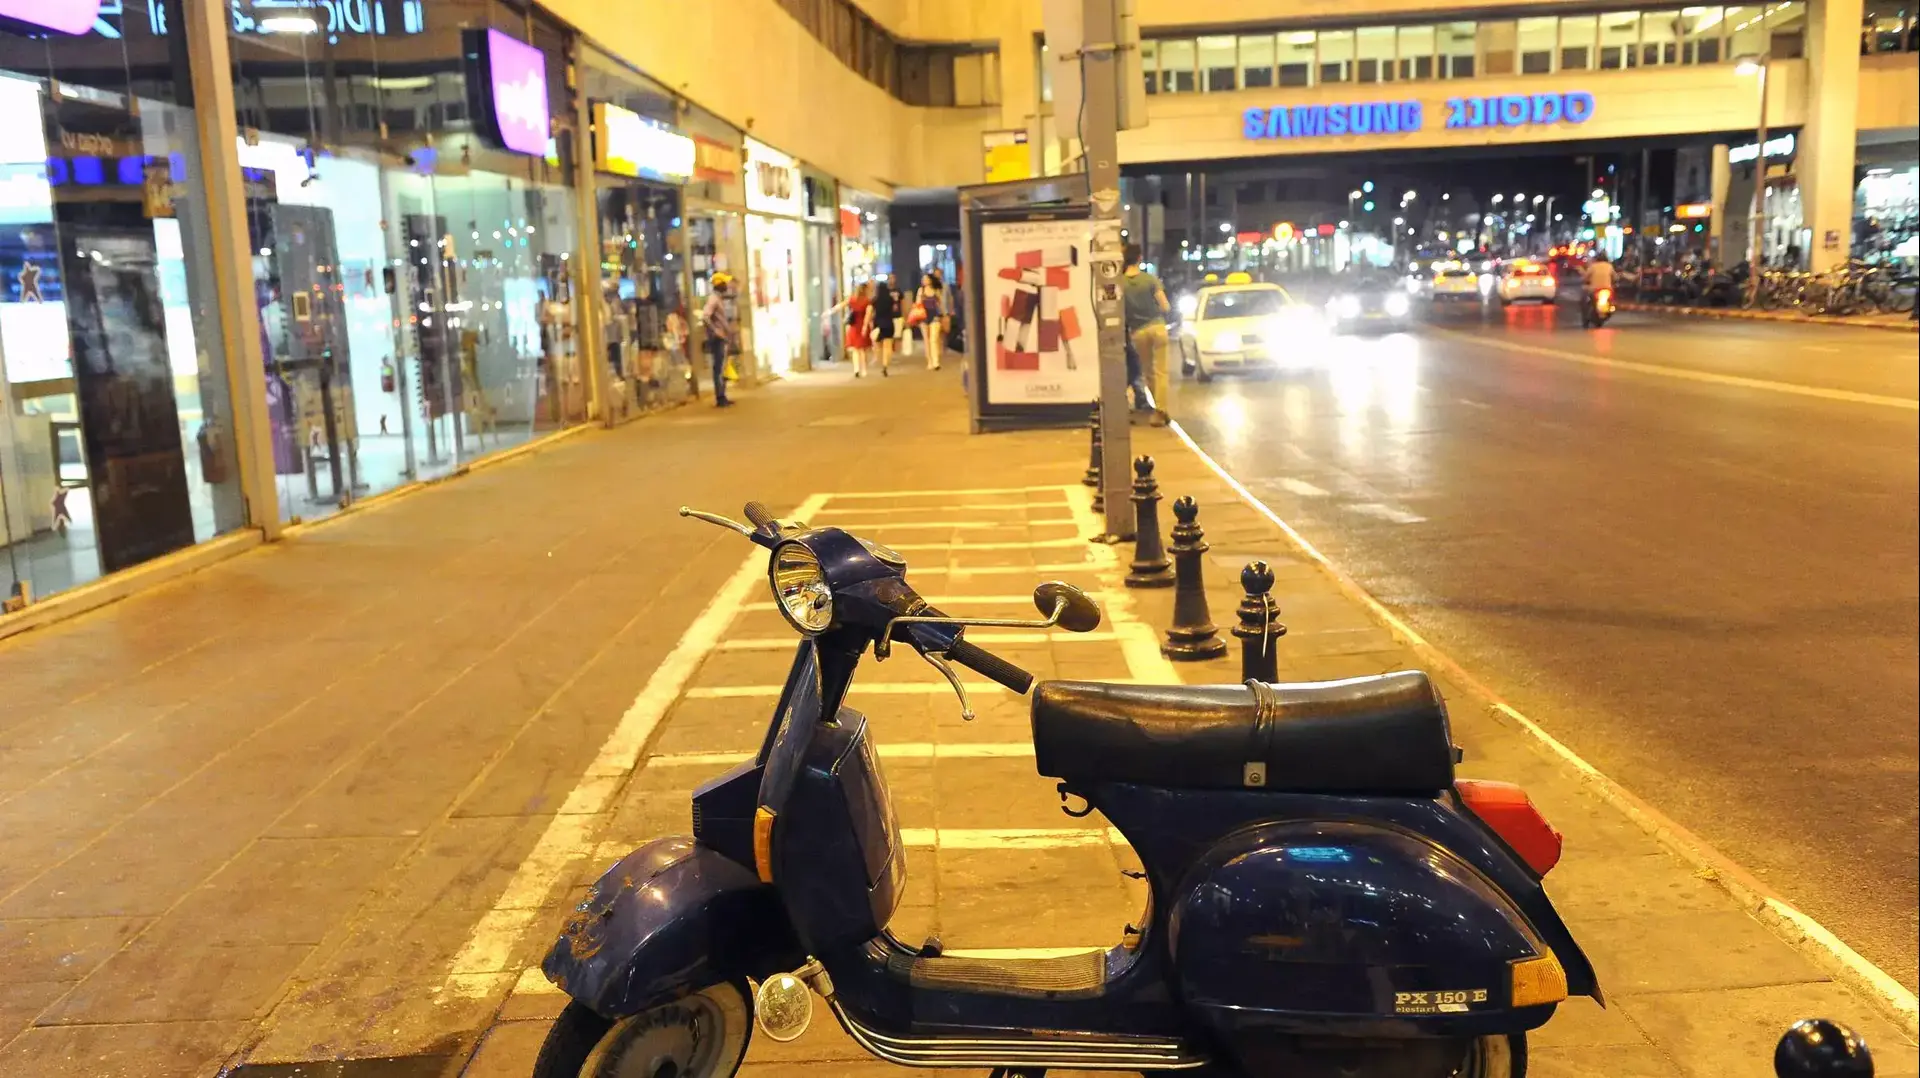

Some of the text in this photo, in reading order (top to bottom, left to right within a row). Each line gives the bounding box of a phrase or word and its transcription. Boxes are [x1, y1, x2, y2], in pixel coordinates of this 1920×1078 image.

[1243, 100, 1423, 139] SAMSUNG
[1446, 91, 1596, 129] סמסונג
[1395, 989, 1488, 1005] PX 150 E
